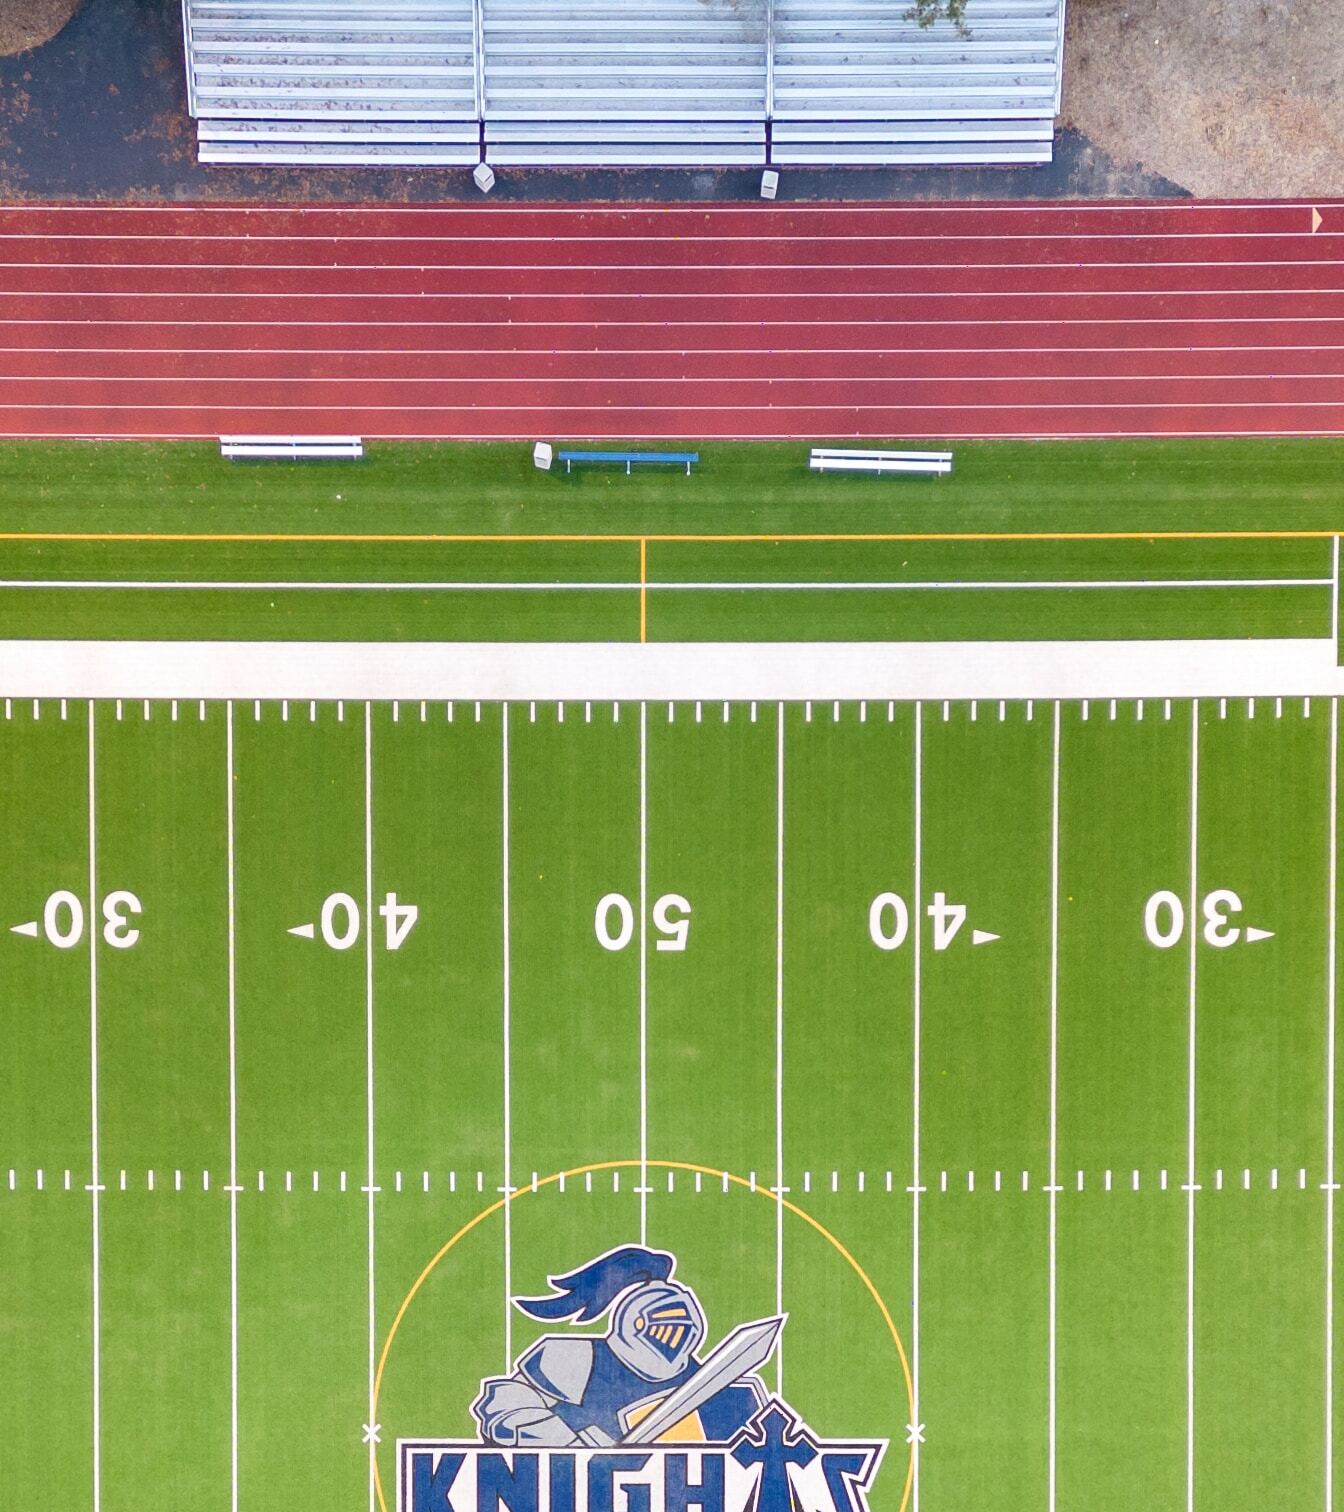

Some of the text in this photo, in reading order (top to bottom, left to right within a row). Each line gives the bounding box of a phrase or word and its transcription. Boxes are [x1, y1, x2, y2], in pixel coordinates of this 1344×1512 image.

[43, 890, 143, 949] 30
[321, 892, 419, 951] 40
[594, 893, 692, 951] 50
[868, 892, 967, 951] 40
[1144, 889, 1243, 948] 30
